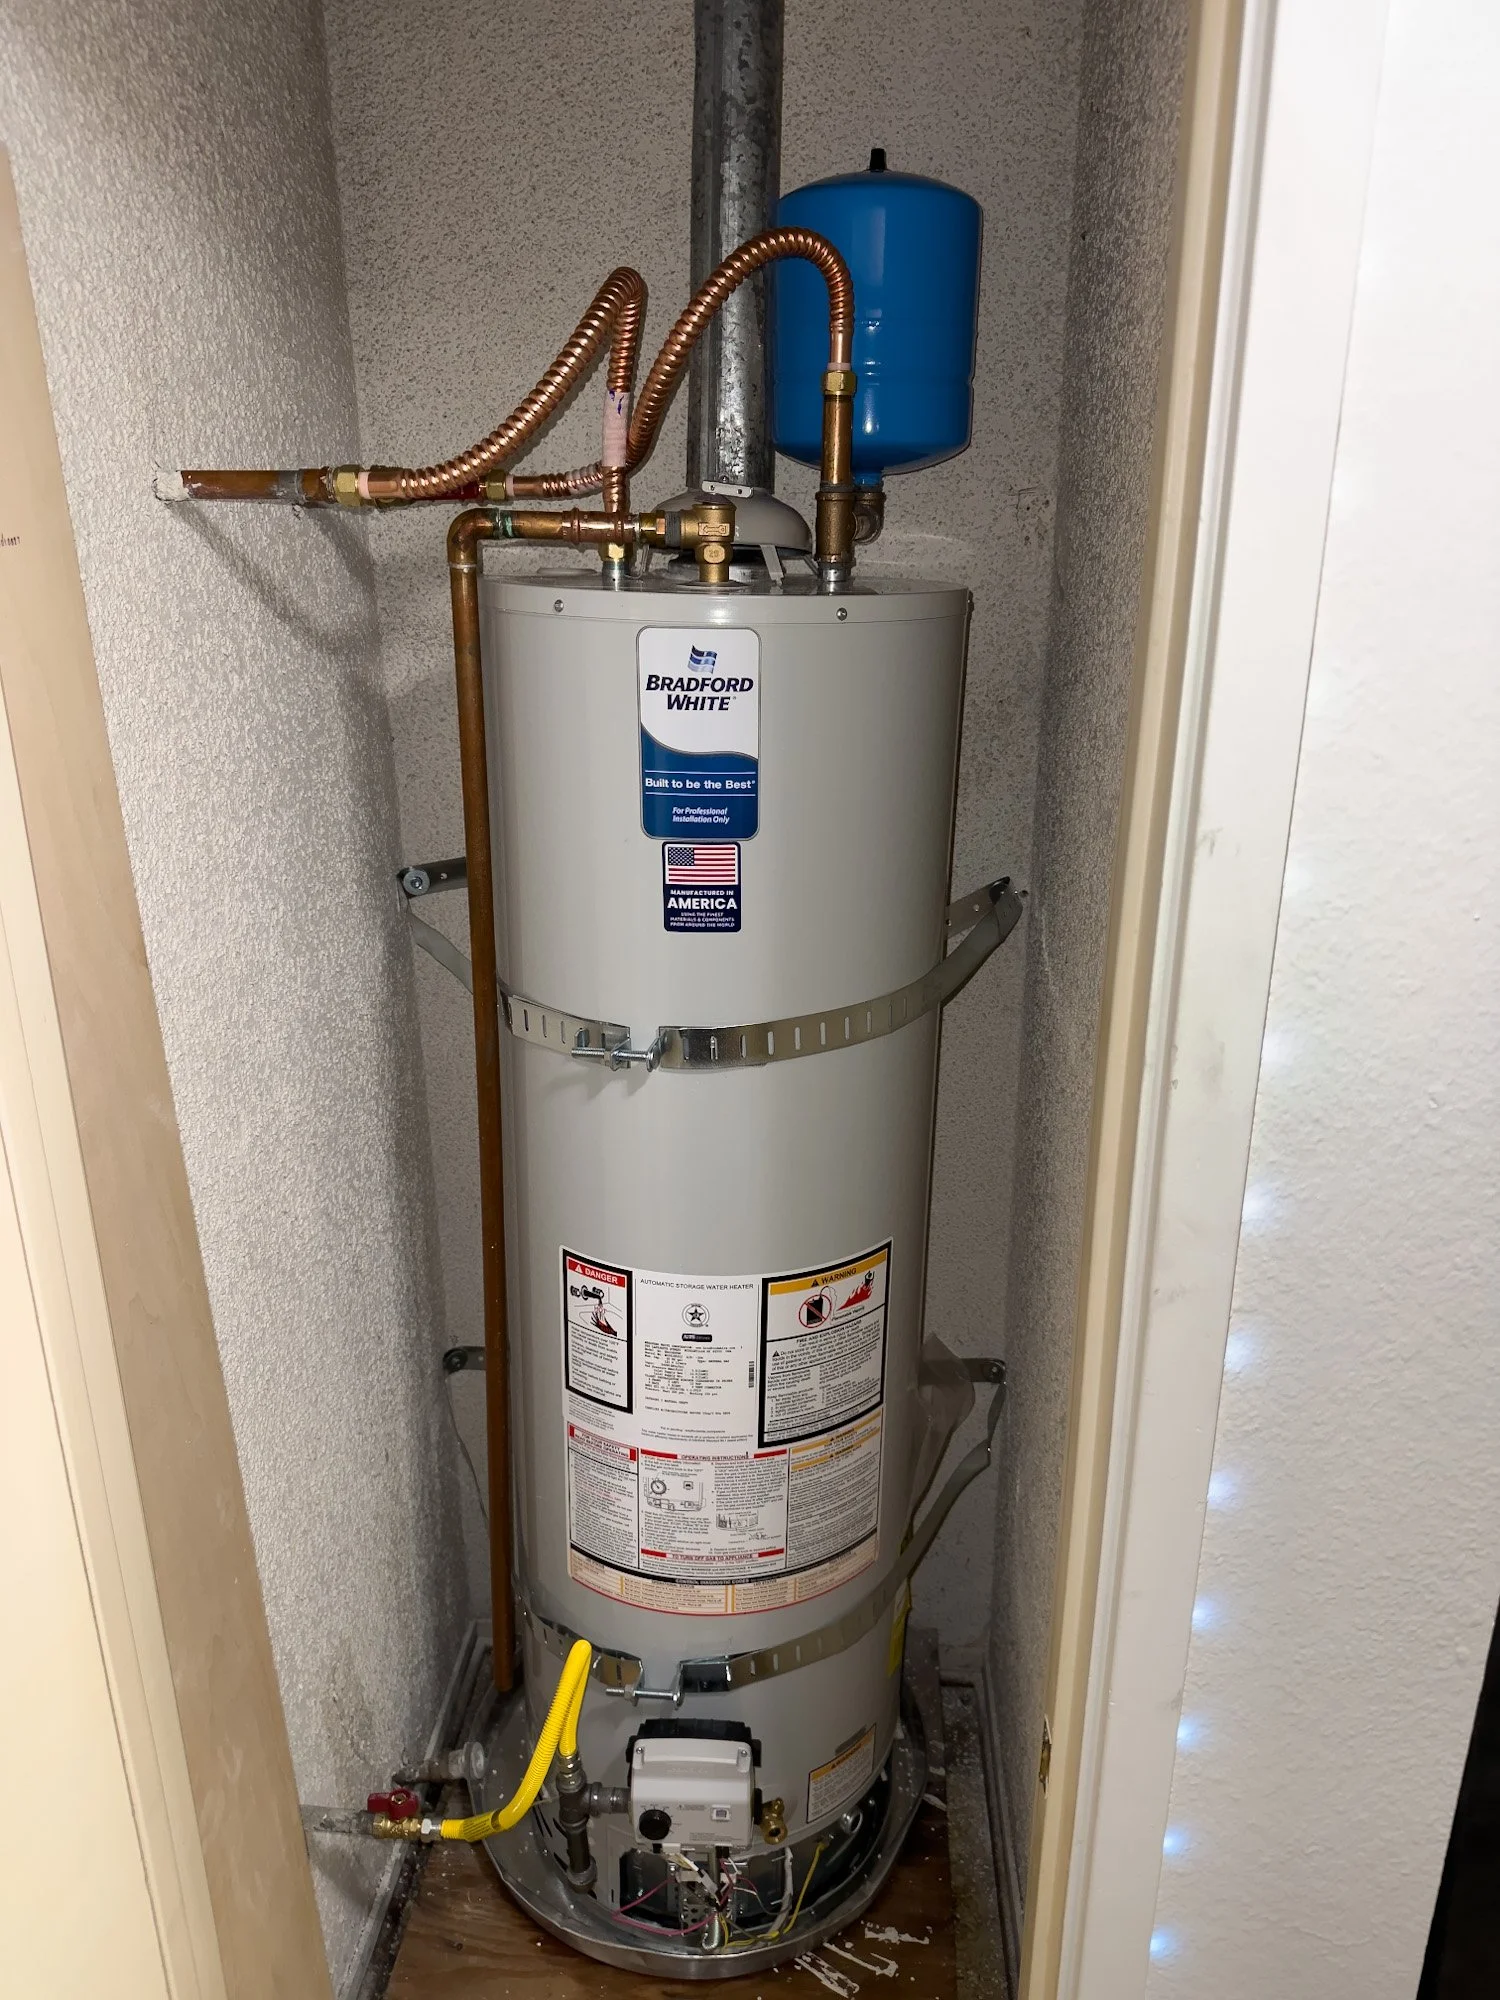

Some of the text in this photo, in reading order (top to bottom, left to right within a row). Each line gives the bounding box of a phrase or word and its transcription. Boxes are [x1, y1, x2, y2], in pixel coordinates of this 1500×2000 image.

[646, 674, 754, 692] BRADFORD
[667, 694, 731, 711] WHITE
[645, 778, 669, 788] Built
[671, 779, 683, 788] to
[686, 779, 700, 789] be
[703, 780, 721, 789] the
[672, 806, 728, 815] For Professional
[672, 815, 730, 825] Installation Only
[667, 897, 738, 910] AMERICA
[585, 1267, 618, 1284] DANGER
[821, 1268, 857, 1284] WARNING
[640, 1278, 675, 1288] AUTOMATIC
